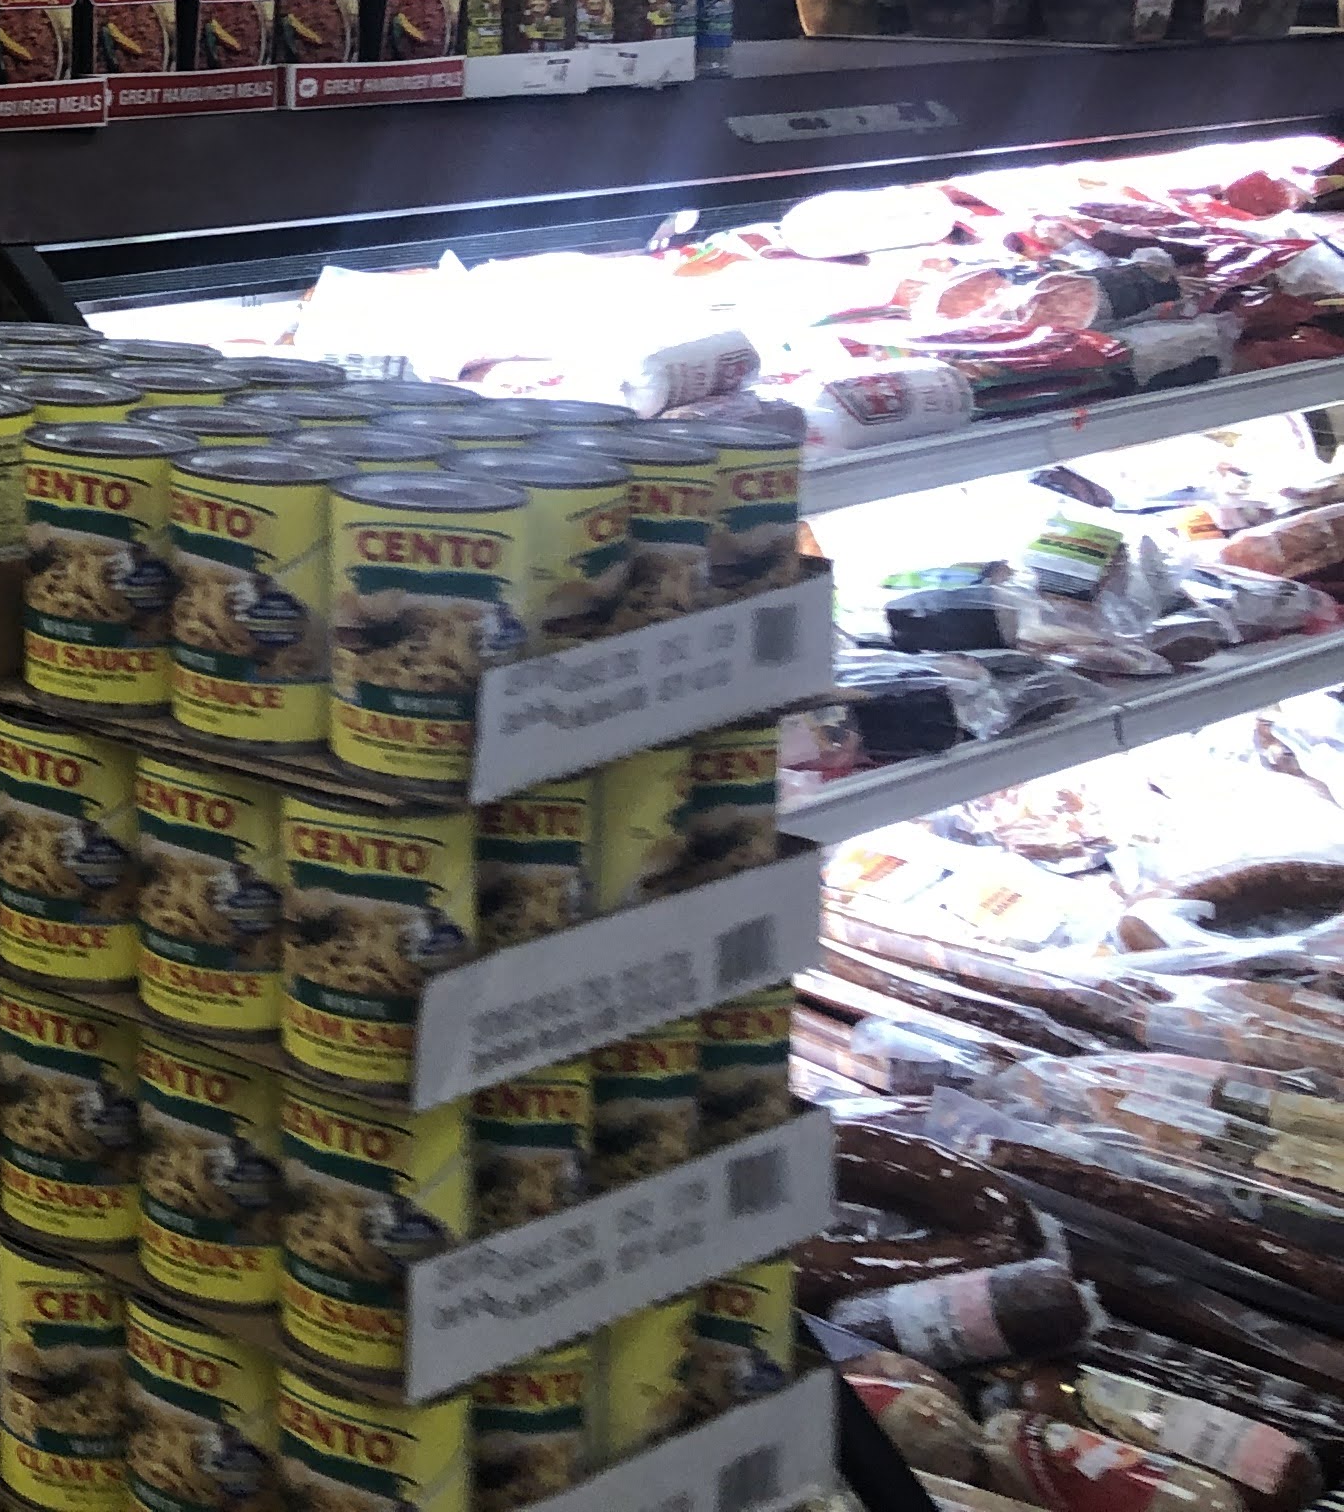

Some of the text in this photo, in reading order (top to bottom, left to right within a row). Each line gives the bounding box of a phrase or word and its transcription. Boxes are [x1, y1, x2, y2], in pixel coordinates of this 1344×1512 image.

[58, 94, 102, 114] MEALS
[26, 467, 132, 511] ENTO
[171, 491, 254, 539] ENTO
[356, 529, 505, 570] CENTO
[138, 777, 237, 829] ENTO
[291, 823, 430, 875] CENTO
[138, 1047, 232, 1102] ENTO
[283, 1101, 391, 1160] ENTO
[34, 1291, 112, 1320] CEN
[128, 1324, 221, 1389] ENTO
